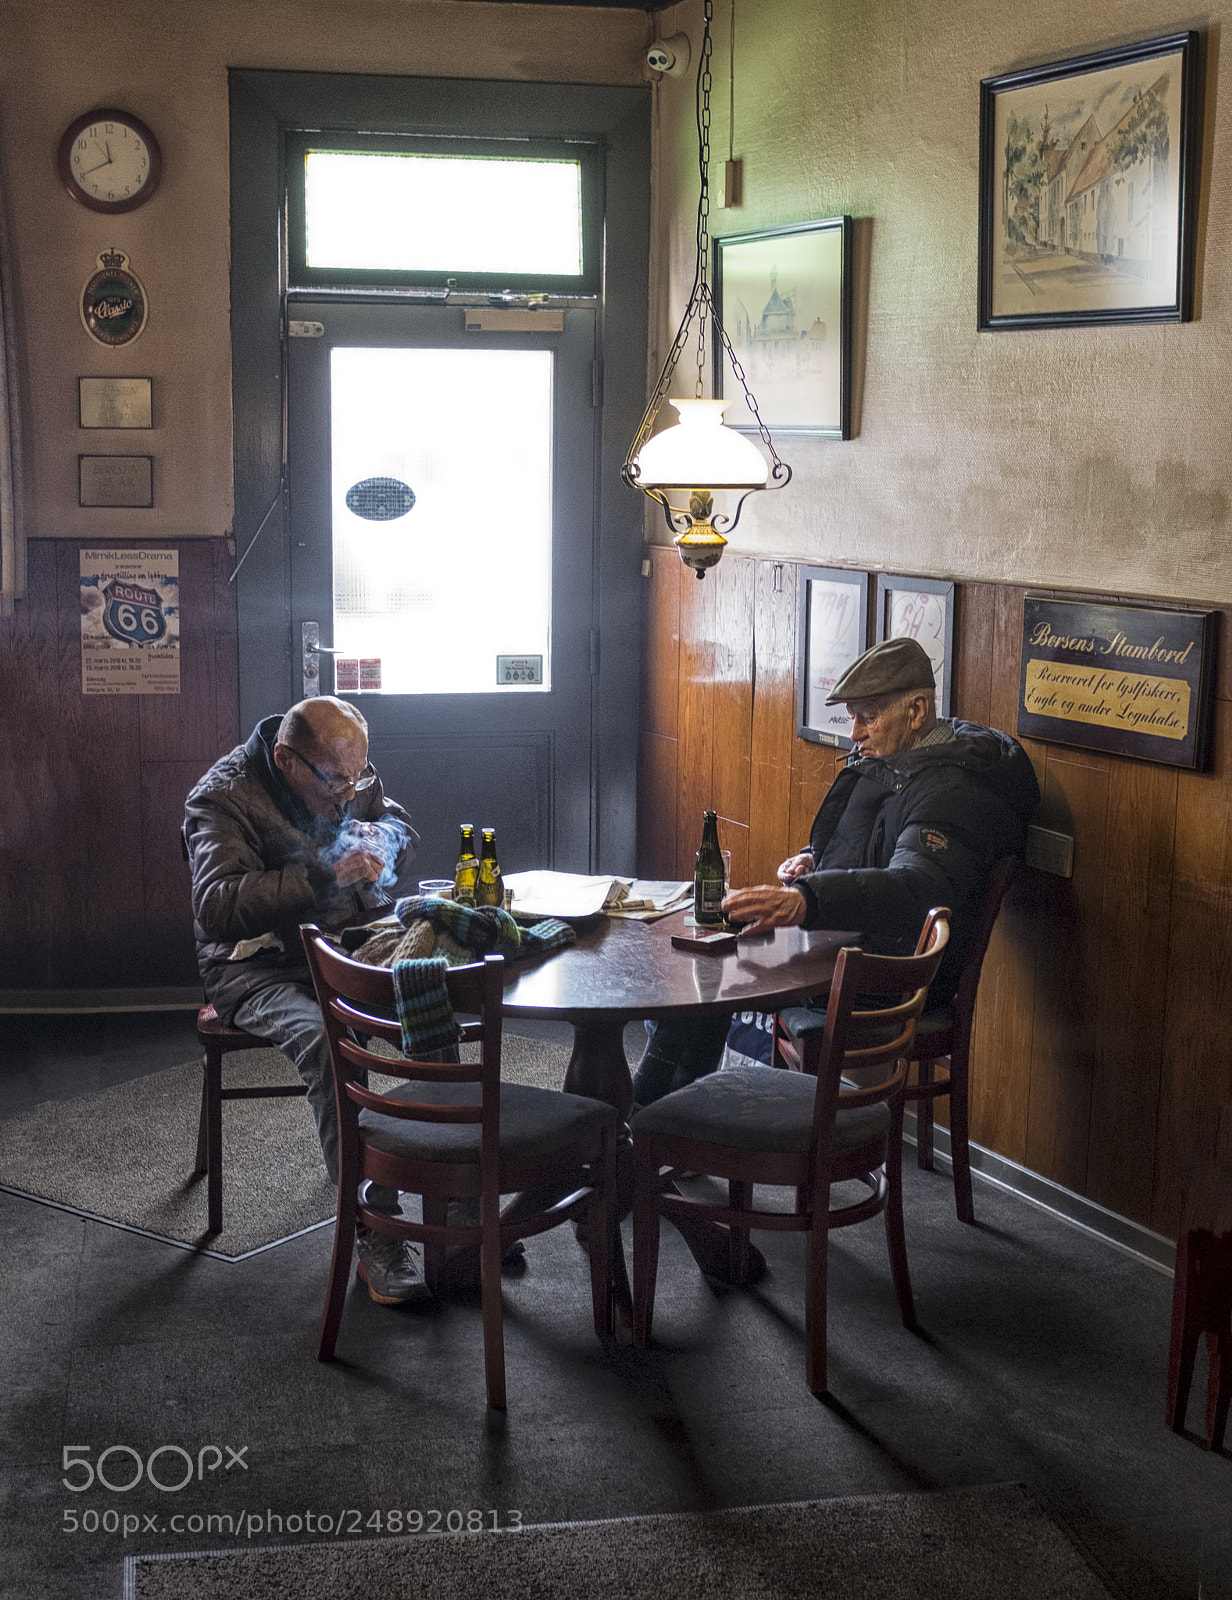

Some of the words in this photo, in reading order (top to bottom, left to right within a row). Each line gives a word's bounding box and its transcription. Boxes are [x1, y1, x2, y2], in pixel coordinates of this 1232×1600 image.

[89, 128, 97, 138] 11
[105, 124, 114, 134] 12
[78, 140, 87, 150] 10
[135, 141, 141, 150] 2
[73, 155, 80, 165] 9
[141, 157, 147, 168] 3
[135, 174, 141, 184] 4
[92, 184, 98, 194] 7
[124, 186, 130, 196] 5
[108, 191, 114, 200] 6
[115, 586, 157, 604] ROUTE
[118, 604, 159, 635] 66
[1100, 629, 1194, 664] Stambord
[1034, 663, 1096, 688] Reserveret
[1092, 673, 1114, 695] for
[1027, 685, 1058, 710] Engle
[1061, 700, 1075, 715] og
[1078, 699, 1111, 716] andre
